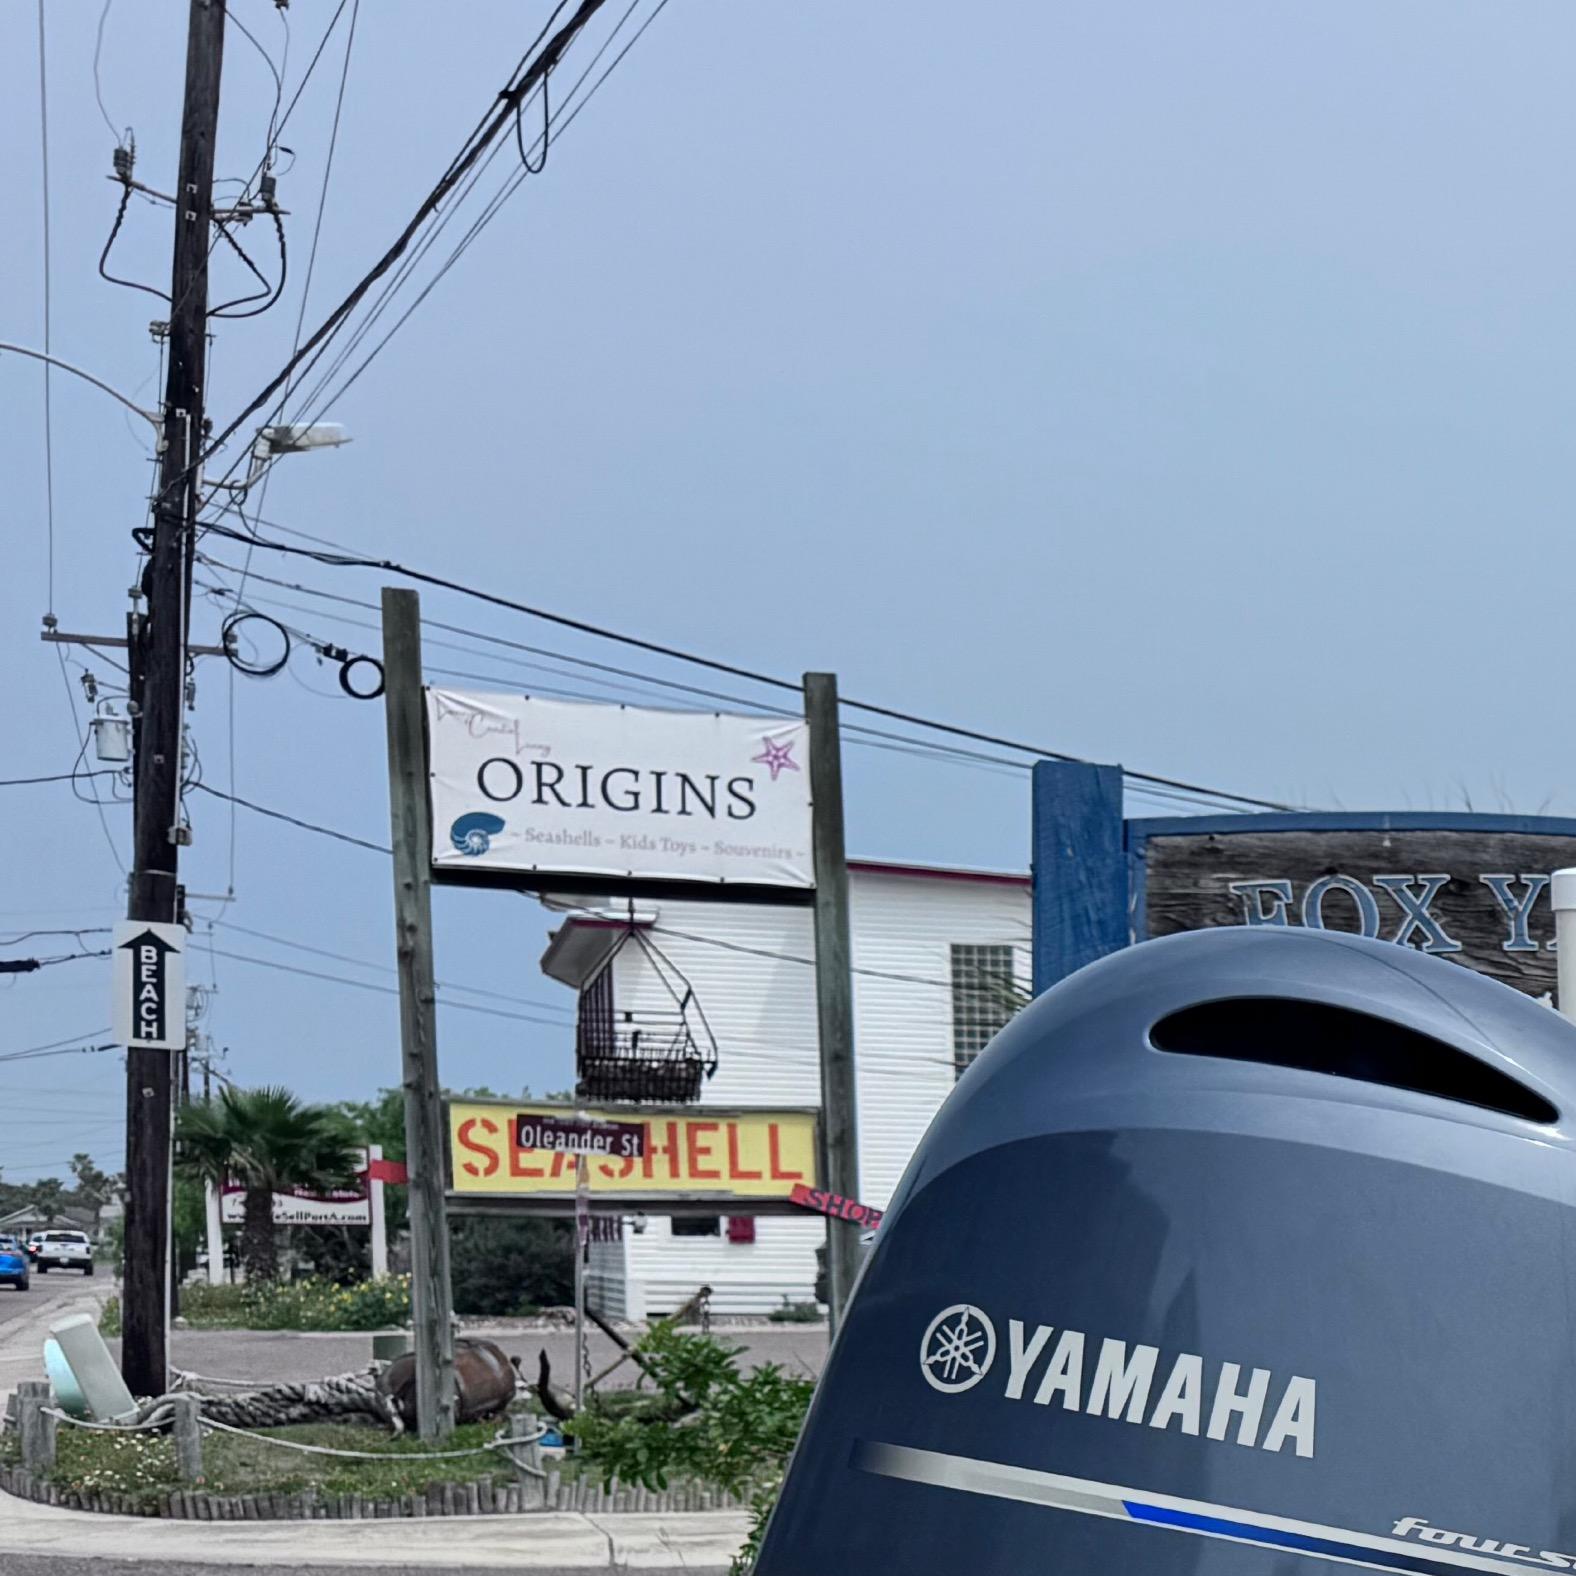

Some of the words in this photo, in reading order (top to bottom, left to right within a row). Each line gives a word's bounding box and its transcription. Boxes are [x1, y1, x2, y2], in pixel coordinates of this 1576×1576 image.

[476, 757, 757, 820] ORIGINS
[525, 827, 601, 848] Seashells
[619, 833, 656, 851] Kids
[660, 837, 696, 856] Toys
[713, 841, 793, 860] Souvenirs
[1229, 873, 1462, 953] FOX
[140, 945, 159, 1039] BEACH
[520, 1124, 614, 1156] Oleander
[620, 1133, 640, 1157] St
[1004, 1318, 1317, 1459] YAMAHA
